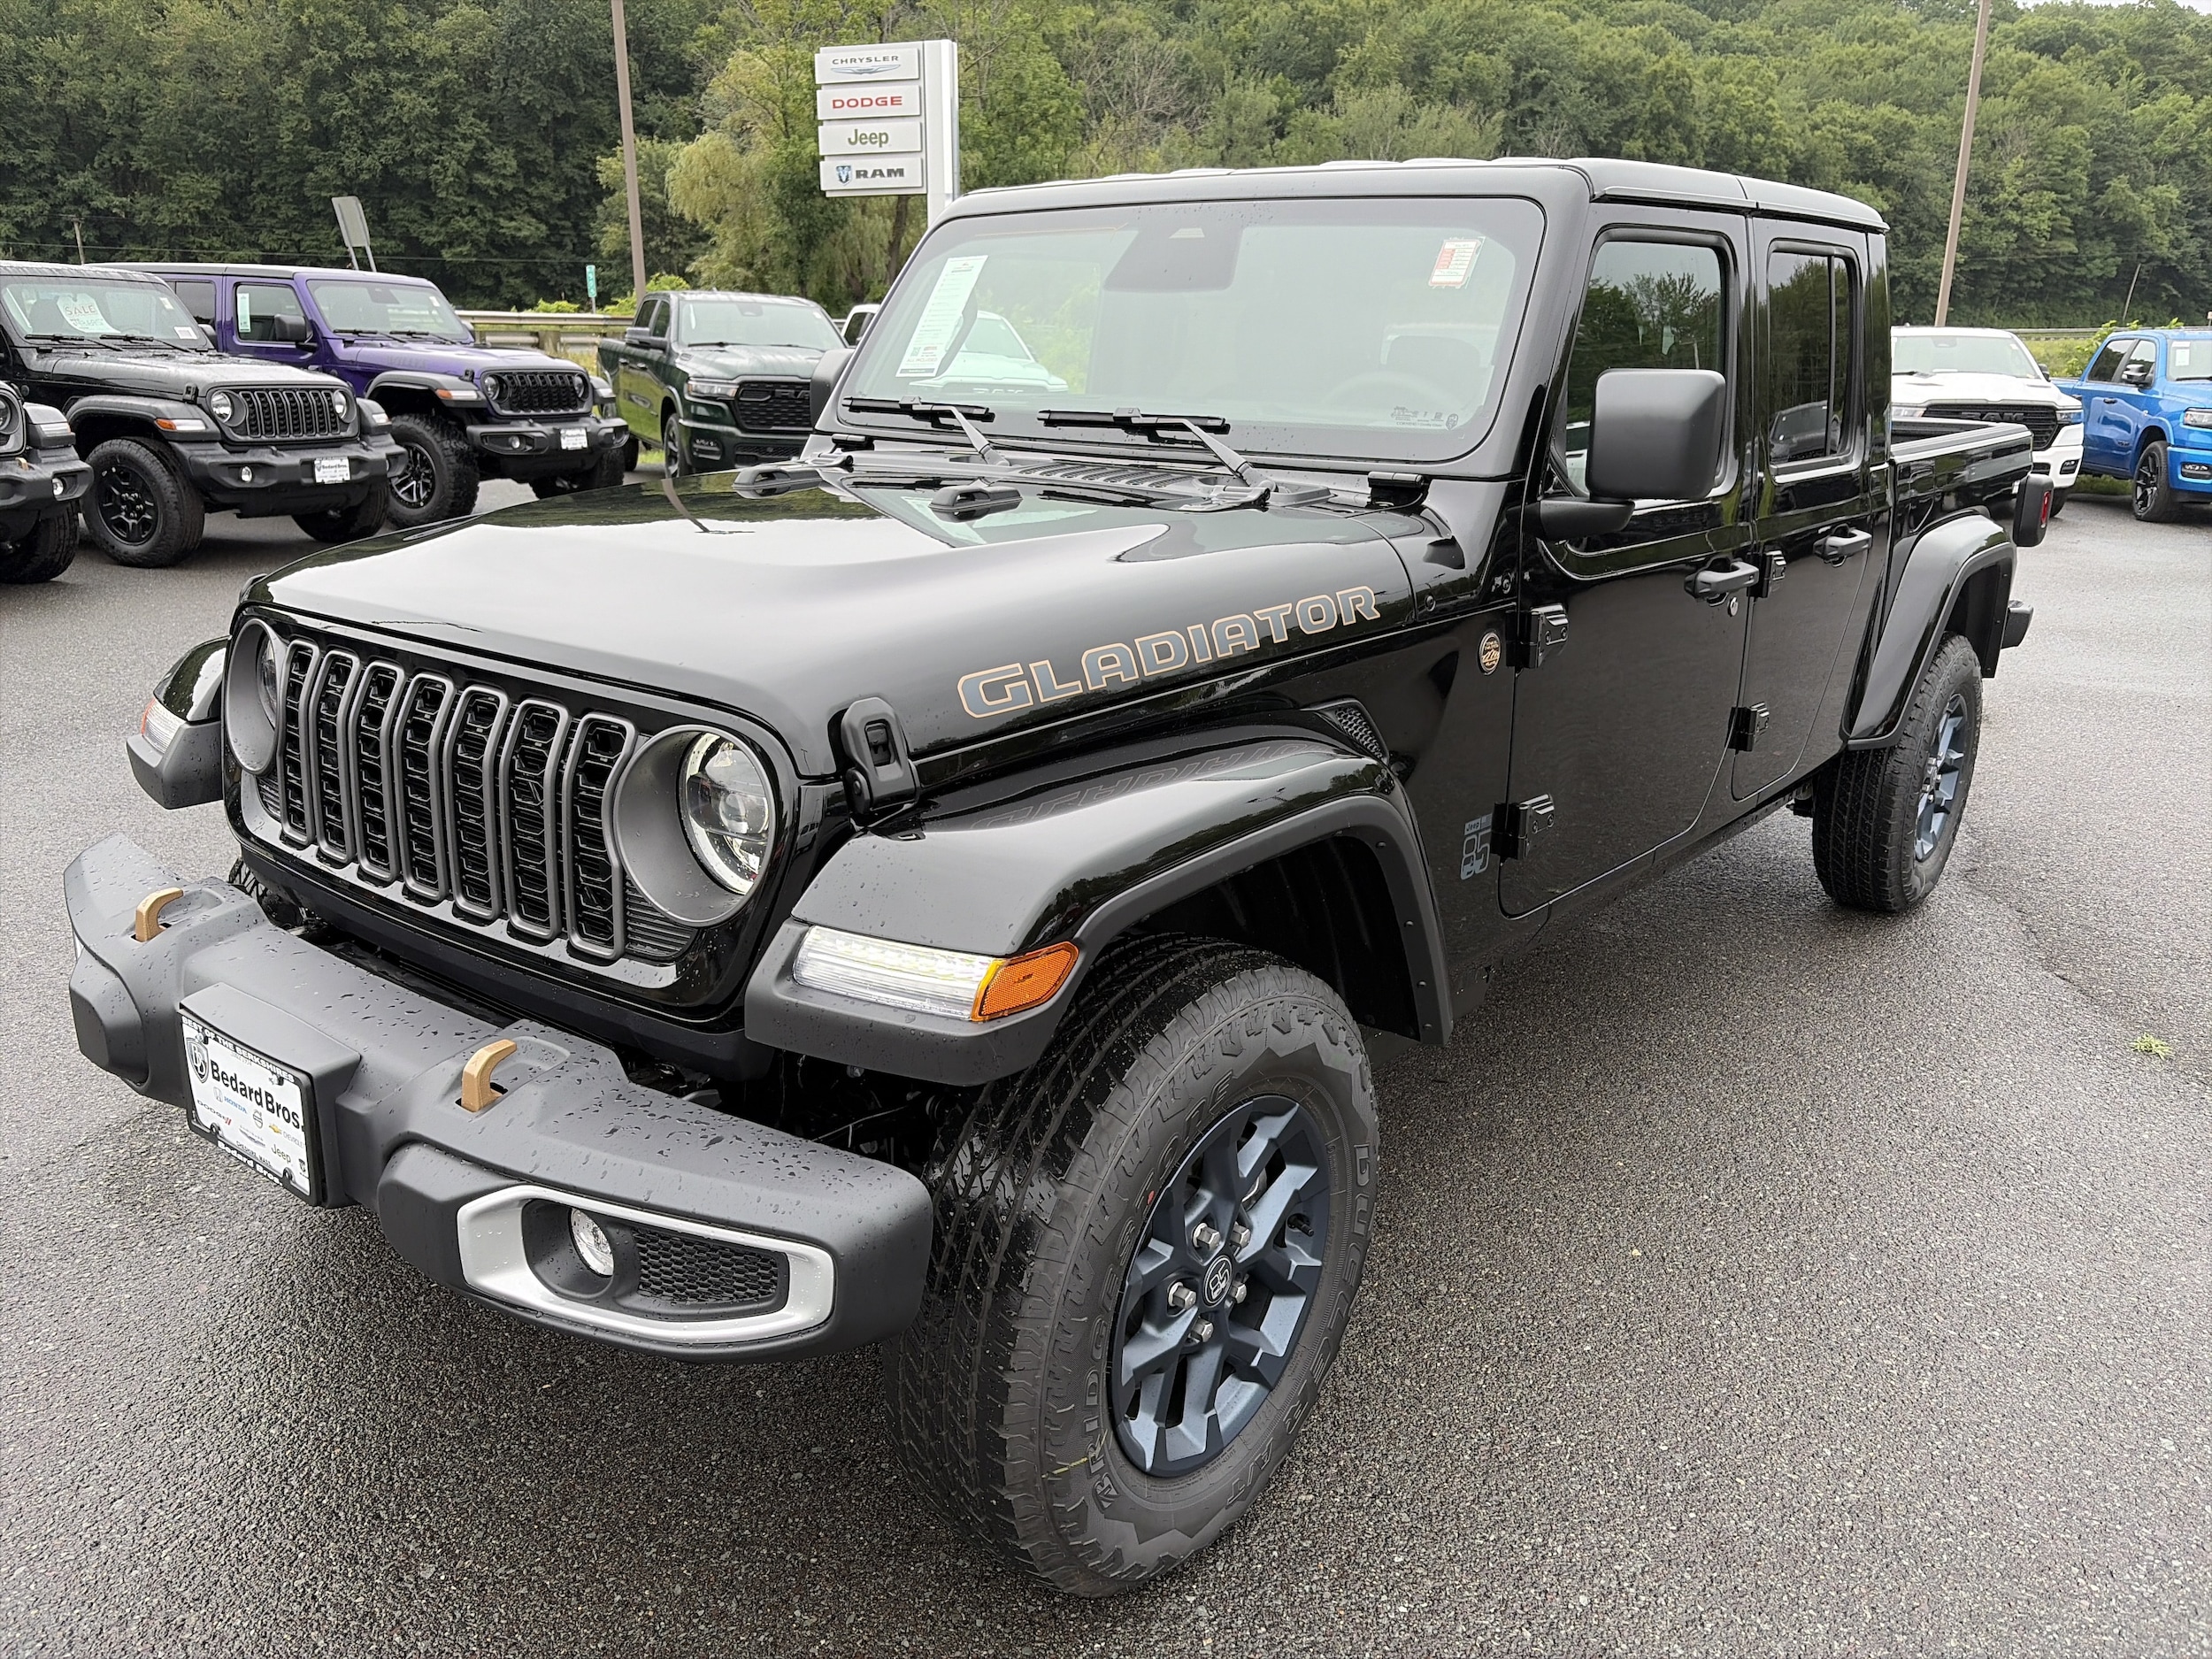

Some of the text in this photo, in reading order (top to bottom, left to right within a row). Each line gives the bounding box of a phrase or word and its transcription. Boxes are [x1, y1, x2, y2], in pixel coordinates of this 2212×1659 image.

[832, 55, 899, 65] CHRYSLER
[832, 96, 902, 109] DODGE
[848, 129, 889, 147] Jeep
[856, 168, 904, 179] RAM
[65, 304, 96, 315] SALE
[775, 388, 810, 399] RA
[1961, 411, 2024, 421] RAM
[956, 585, 1381, 718] GLADIATOR
[1461, 829, 1493, 880] 85
[181, 1016, 203, 1033] BEST
[204, 1029, 215, 1039] OF
[216, 1035, 234, 1051] THE
[234, 1046, 296, 1083] BERKSHIRES
[217, 1139, 254, 1168] Bedard
[256, 1163, 283, 1187] Bros.
[271, 1143, 292, 1164] Jeep
[1083, 1069, 1233, 1512] BRIDGESTONE
[1282, 1142, 1371, 1436] DUELER
